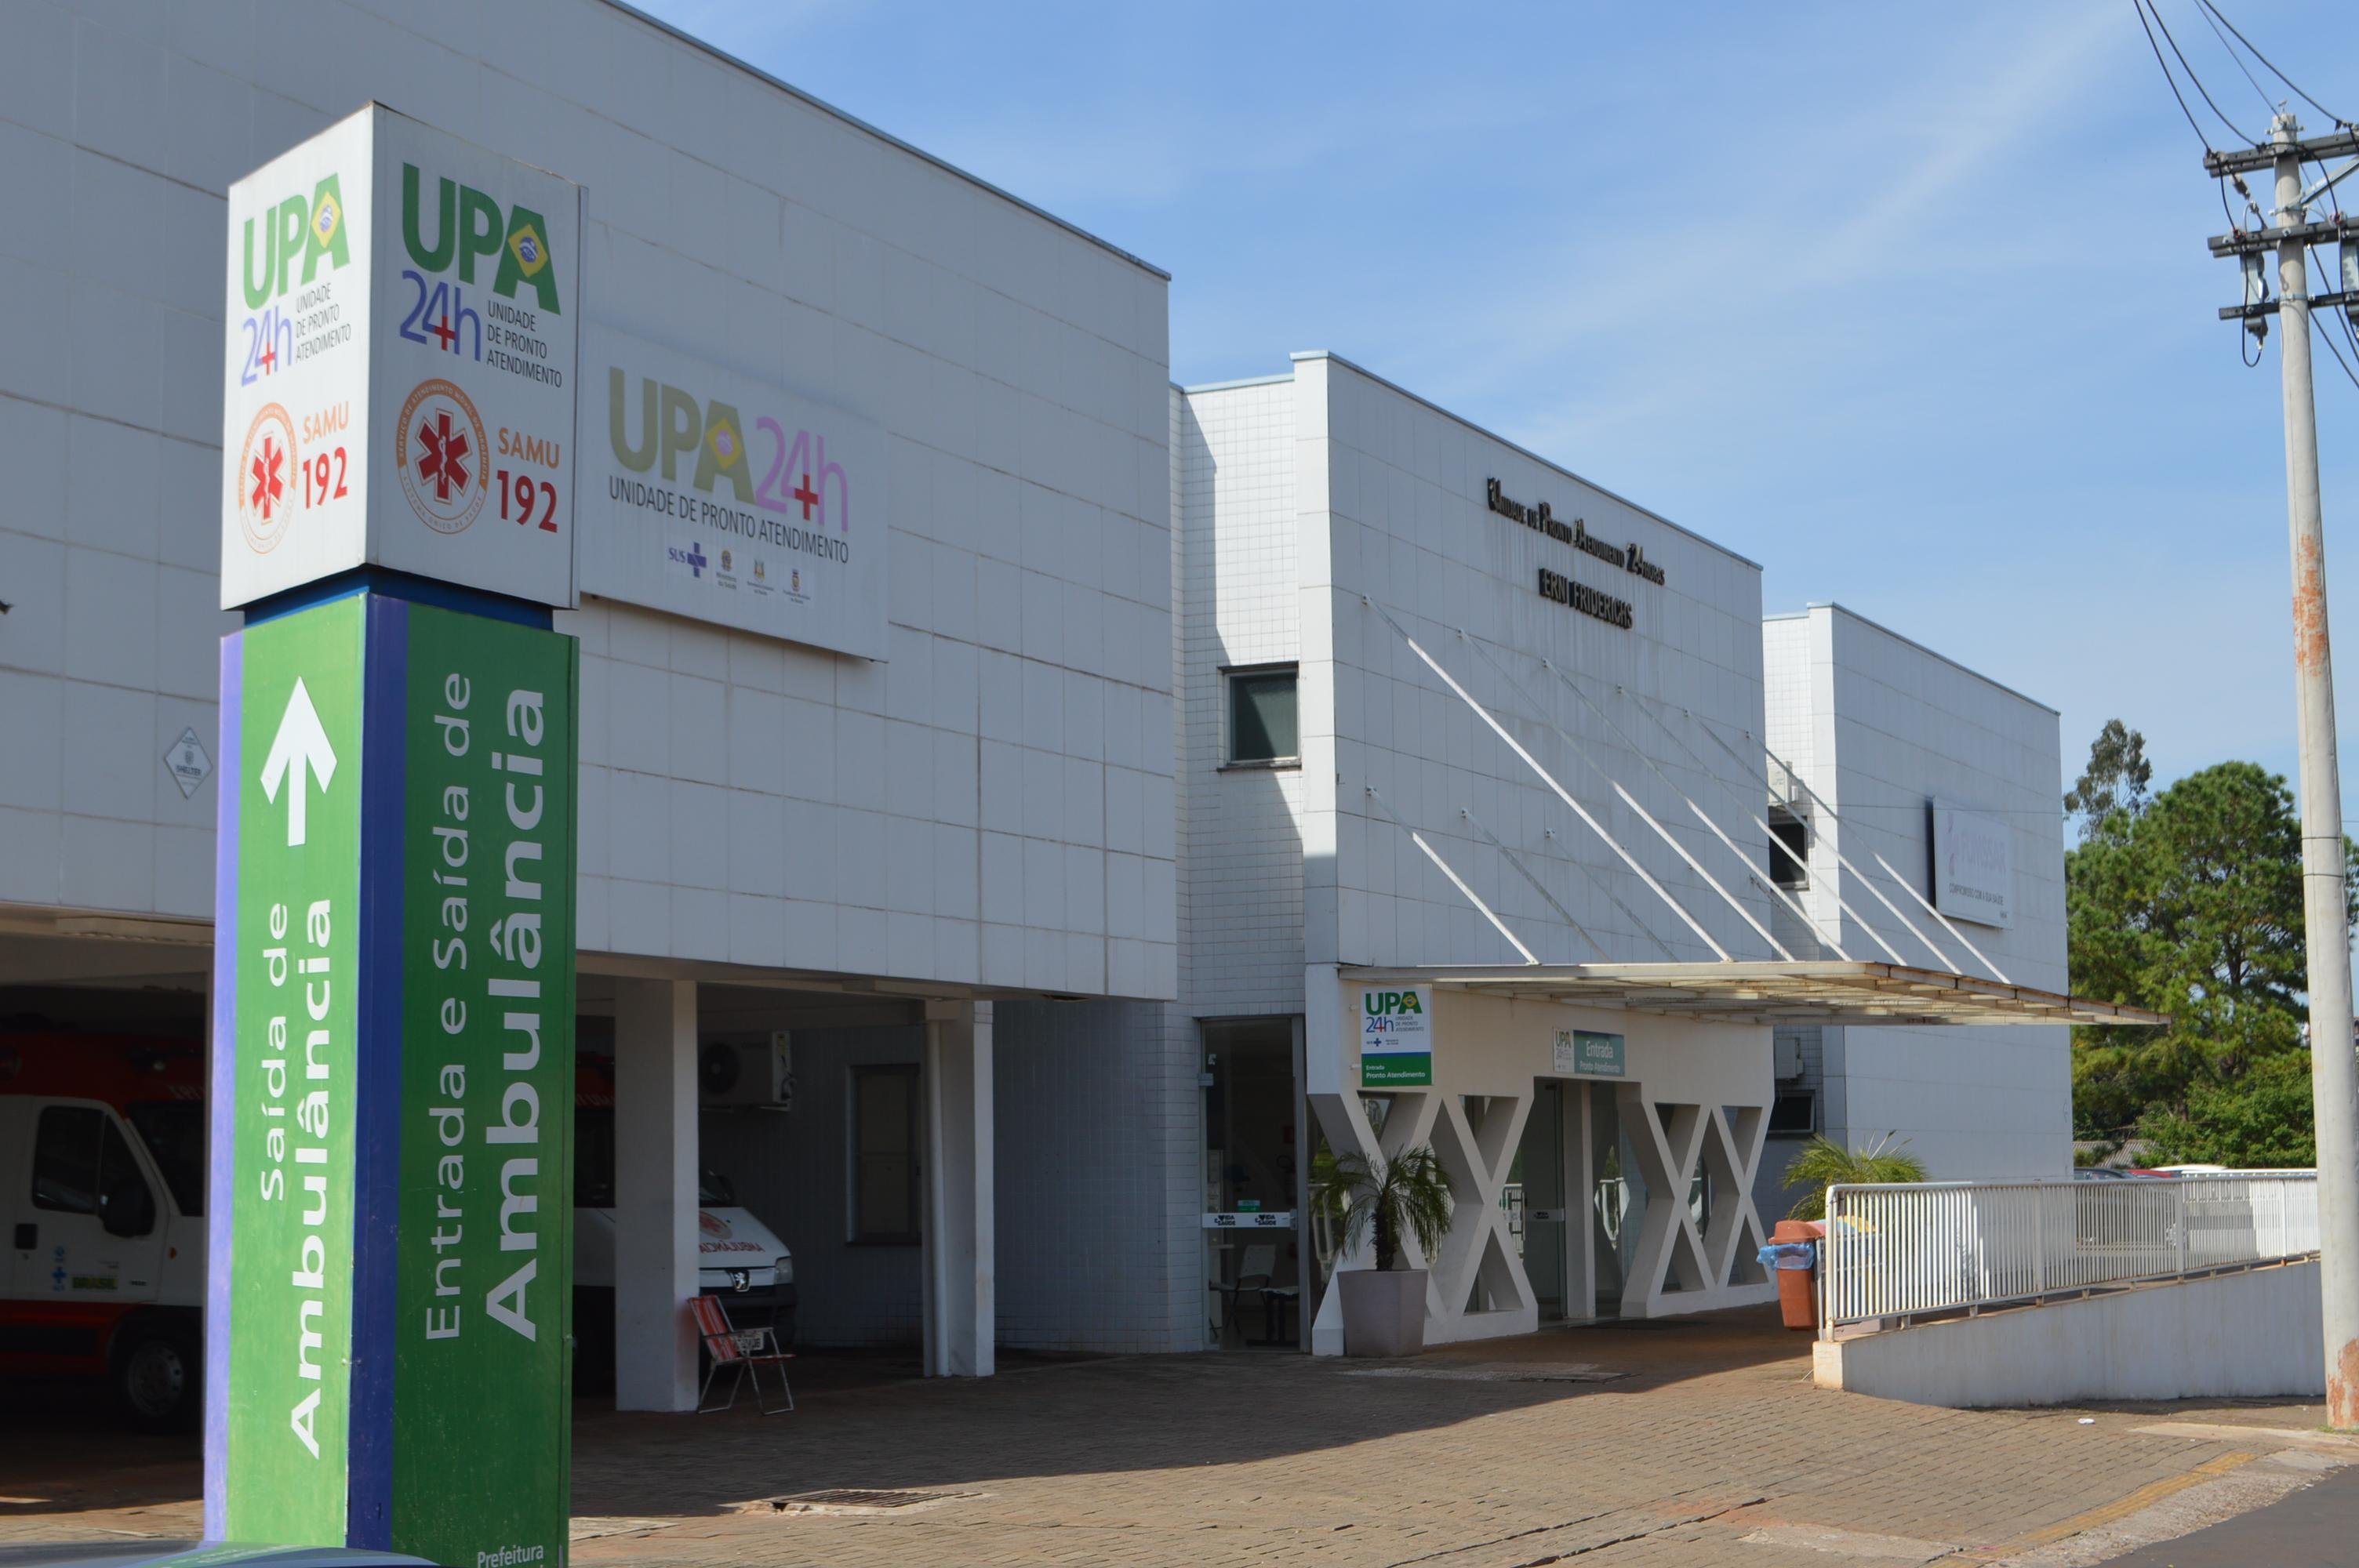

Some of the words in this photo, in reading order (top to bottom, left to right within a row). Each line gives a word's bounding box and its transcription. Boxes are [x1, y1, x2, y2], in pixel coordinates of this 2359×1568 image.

[243, 172, 350, 310] UPA
[402, 162, 562, 315] UPA
[296, 283, 331, 314] UNIDADE
[400, 270, 481, 362] 24h
[488, 299, 536, 332] UNIDADE
[296, 319, 307, 339] DE
[308, 303, 340, 332] PRONTO
[296, 323, 351, 363] ATENDIMENTO
[488, 324, 502, 345] DE
[505, 330, 547, 359] PRONTO
[241, 305, 293, 387] 24h
[487, 350, 562, 389] ATENDIMENTO
[304, 401, 349, 445] SAMU
[498, 426, 561, 470] SAMU
[609, 365, 757, 505] UPA
[754, 416, 849, 533] 24h
[304, 447, 348, 510] 192
[496, 470, 558, 534] 192
[609, 475, 674, 517] UNIDADE
[679, 495, 697, 522] DE
[702, 503, 756, 538] PRONTO
[759, 519, 849, 564] ATENDIMENTO
[668, 547, 686, 563] SUS
[1538, 568, 1568, 604] ERNI
[434, 673, 471, 757] de
[432, 786, 469, 970] Saída
[263, 903, 288, 986] de
[440, 997, 467, 1034] e
[485, 688, 545, 1342] Ambulância
[1365, 991, 1423, 1016] UPA
[1365, 1016, 1394, 1033] 24h
[1555, 1030, 1572, 1048] UPA
[1586, 1040, 1613, 1059] Entrada
[260, 1016, 287, 1201] Saída
[290, 899, 331, 1460] Ambulância
[426, 1063, 467, 1341] Entrada
[477, 1544, 544, 1568] Prefeitura
